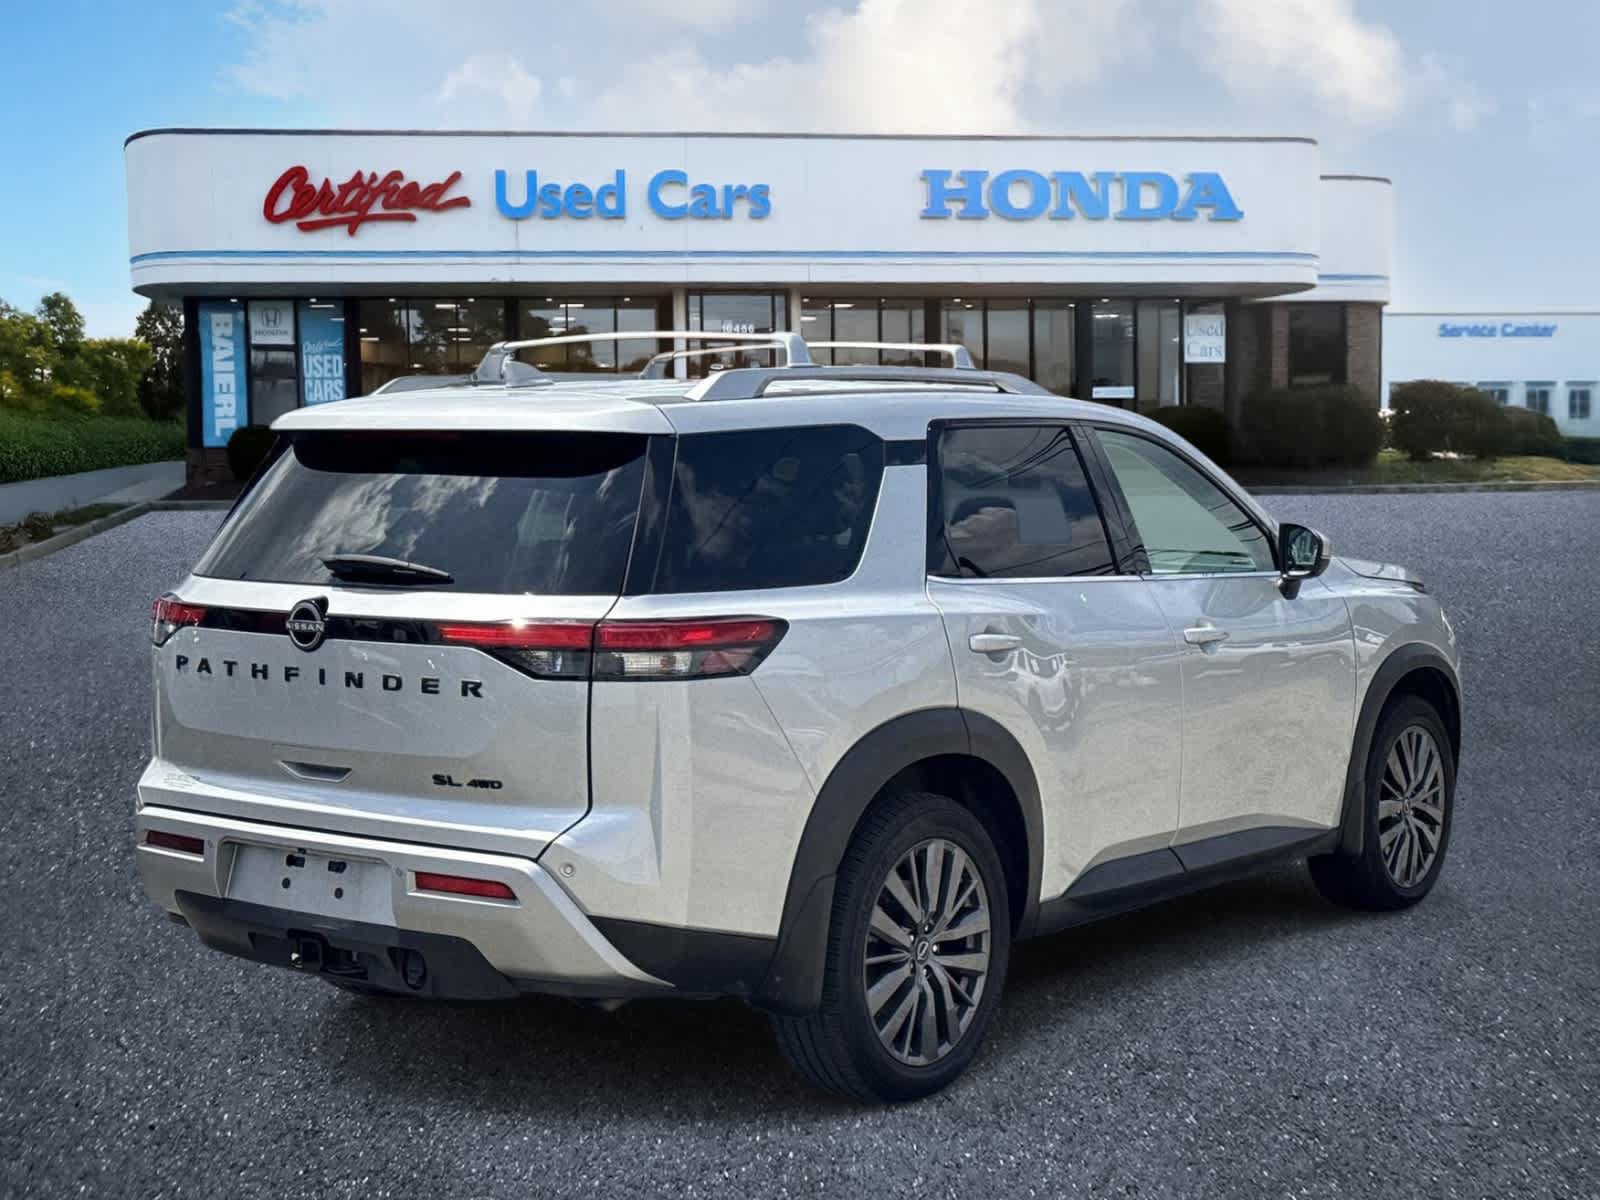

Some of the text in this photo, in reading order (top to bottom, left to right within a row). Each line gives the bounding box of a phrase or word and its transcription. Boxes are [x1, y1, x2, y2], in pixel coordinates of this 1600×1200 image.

[264, 165, 772, 235] Certified Used Cars
[919, 169, 1245, 221] HONDA
[1186, 319, 1224, 336] Used
[1439, 323, 1557, 337] Service Center
[1187, 342, 1223, 357] Cars
[211, 313, 237, 437] BAIERL
[304, 354, 343, 377] USED
[305, 379, 344, 401] CARS
[286, 621, 324, 632] NISSAN
[175, 654, 484, 698] PATHFINDER
[432, 774, 503, 789] SL 4WD
